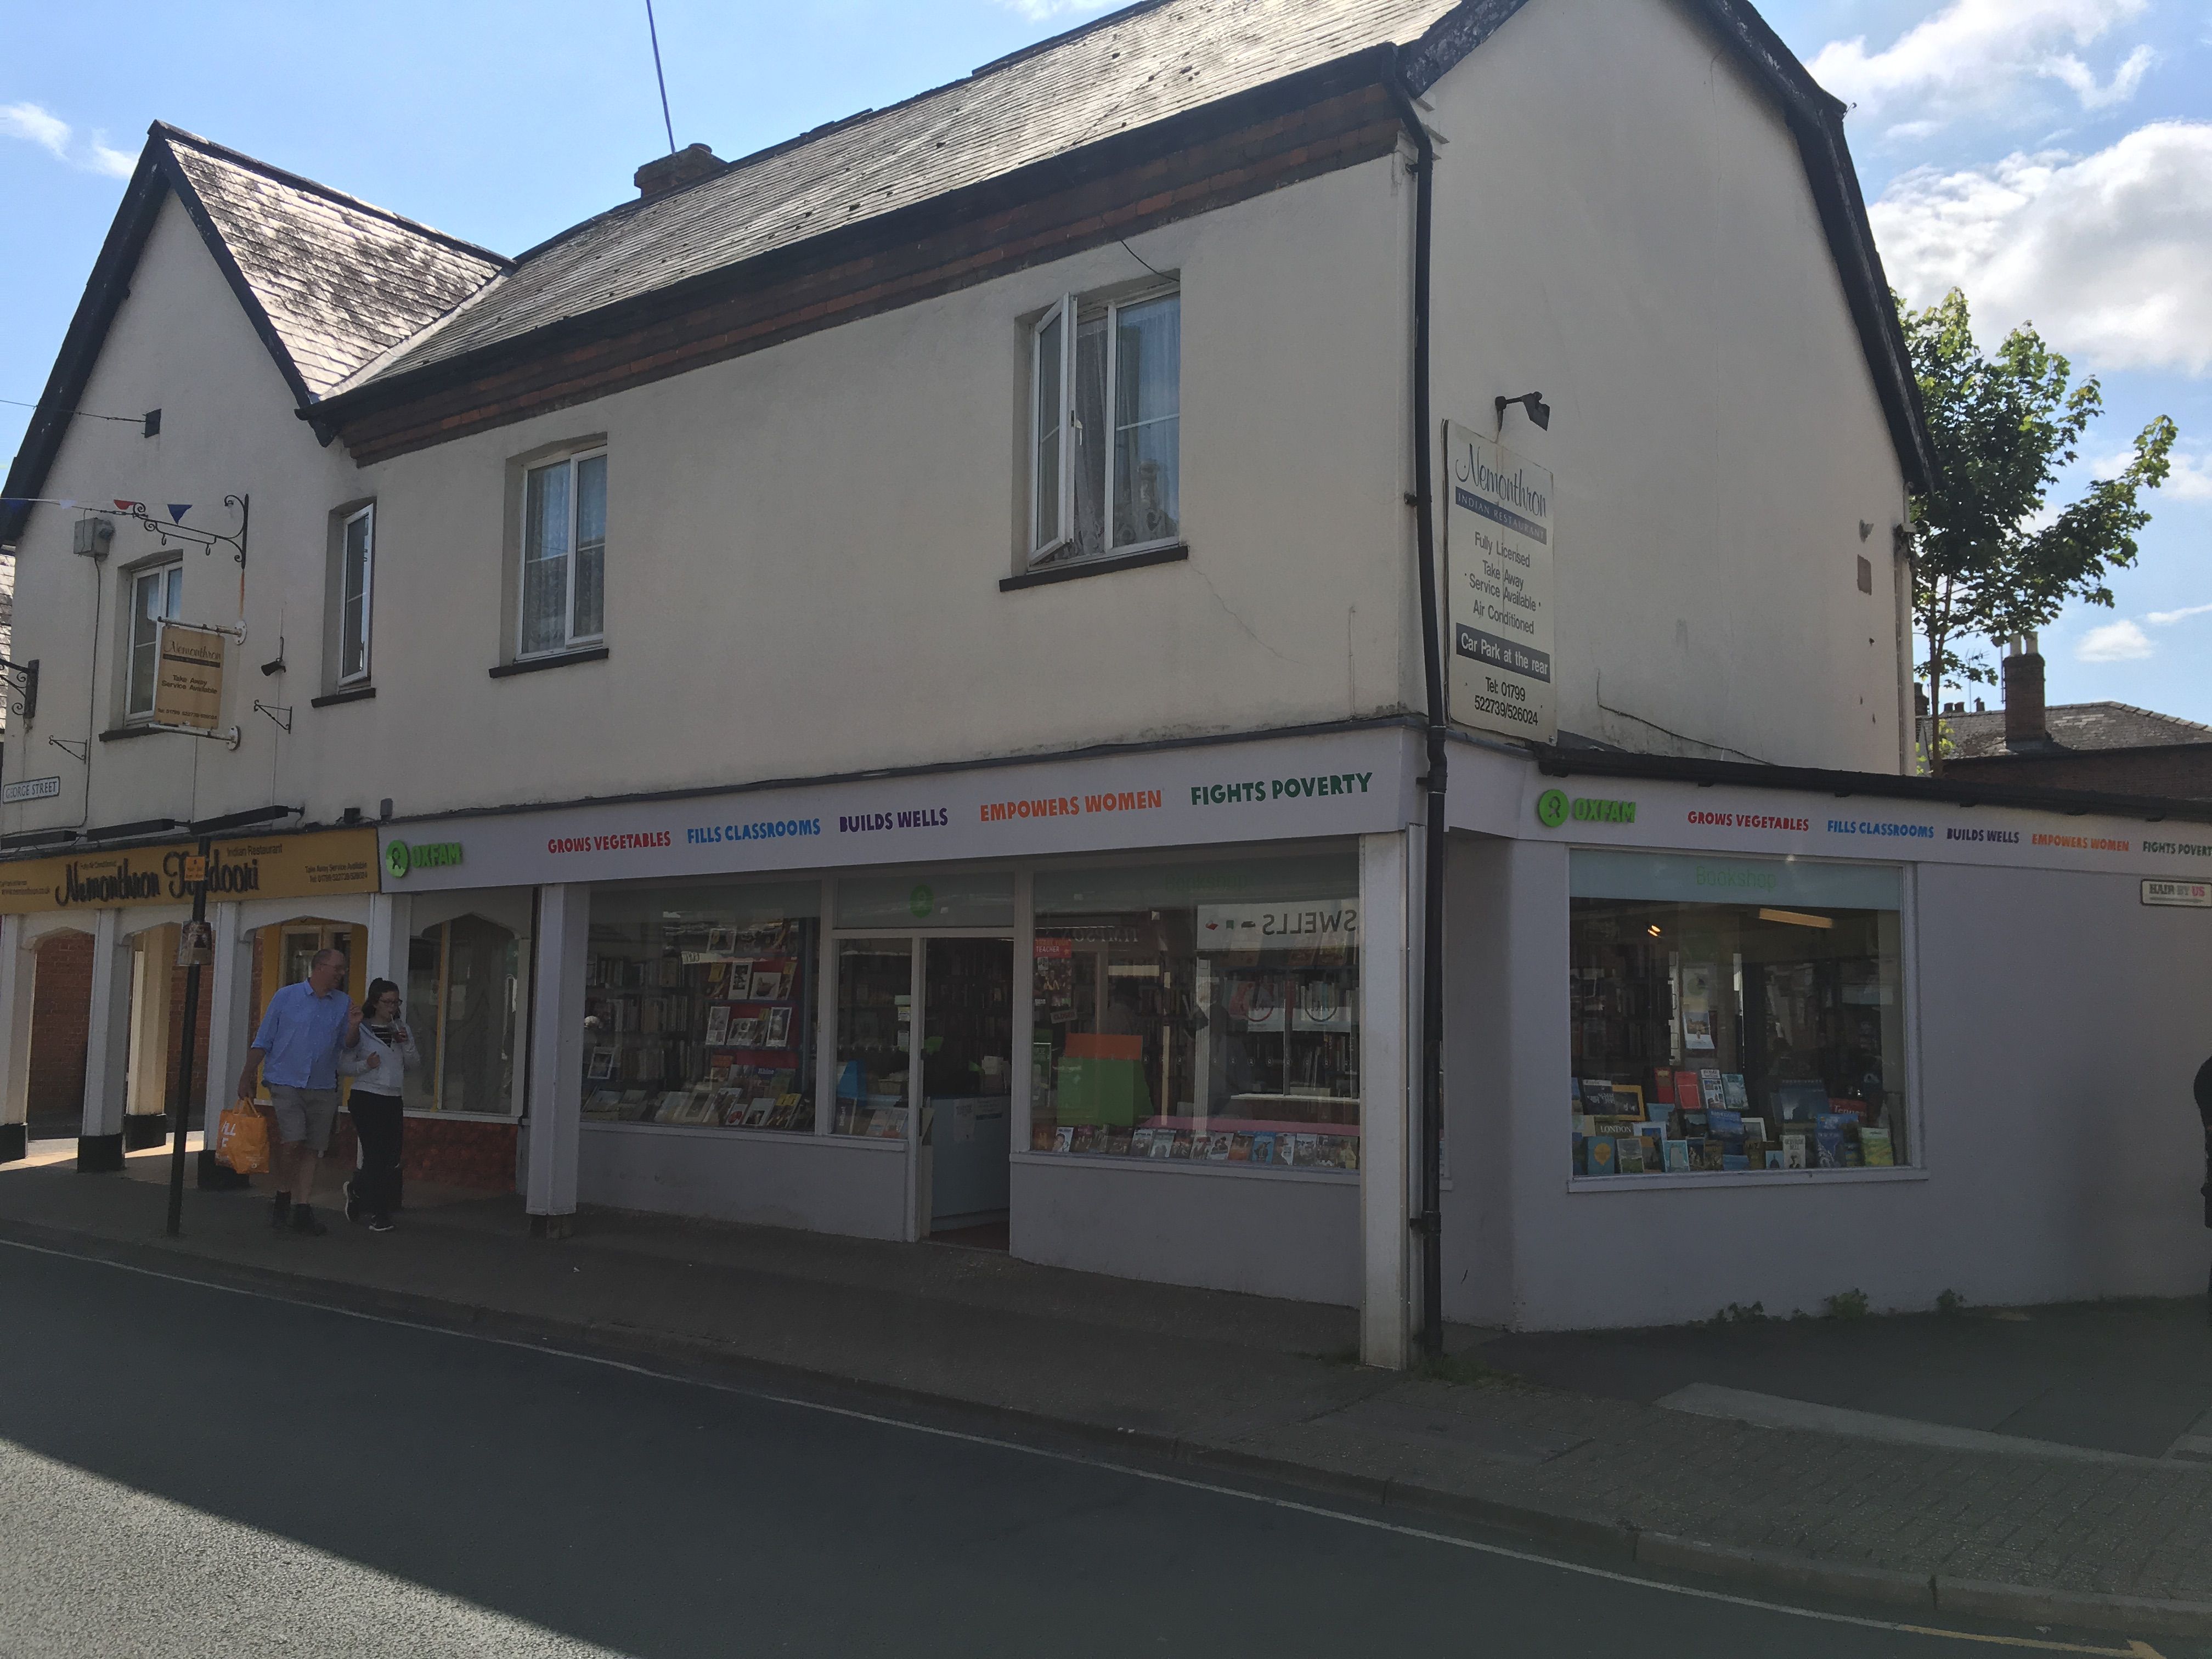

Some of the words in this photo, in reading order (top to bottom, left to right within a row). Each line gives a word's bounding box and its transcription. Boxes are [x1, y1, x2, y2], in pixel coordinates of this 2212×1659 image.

[1455, 443, 1547, 517] Nemonthron
[1458, 493, 1490, 514] INDIAN
[1494, 509, 1544, 539] RESTAURANT
[1475, 532, 1492, 555] Fully
[1497, 541, 1530, 568] Licensed
[1482, 560, 1500, 579] Take
[1504, 569, 1523, 591] Away
[1470, 573, 1500, 597] Service
[1504, 587, 1536, 612] Available
[1473, 600, 1485, 616] Air
[1488, 605, 1534, 635] Conditioned
[163, 641, 221, 660] Nemonthron
[1461, 633, 1477, 652] Car
[1481, 639, 1500, 660] Park
[1504, 648, 1512, 664] at
[1515, 651, 1528, 669] the
[1532, 659, 1548, 675] rear
[161, 680, 187, 689] Service
[189, 685, 218, 694] Available
[173, 675, 187, 683] Take
[190, 678, 208, 686] Away
[1485, 676, 1498, 694] Tel:
[1501, 682, 1525, 702] 01799
[1474, 695, 1538, 726] 522739/526024
[5, 785, 30, 799] GEORGE
[32, 781, 57, 795] STREET
[548, 837, 591, 854] GROWS
[595, 831, 671, 851] VEGETABLES
[687, 826, 721, 844] FILLS
[725, 818, 821, 841] CLASSROOMS
[839, 812, 893, 833] BUILDS
[897, 808, 949, 828] WELLS
[980, 797, 1080, 822] EMPOWERS
[1084, 789, 1162, 812] WOMEN
[1190, 781, 1266, 806] FIGHTS
[1272, 772, 1373, 799] POVERTY
[1575, 798, 1637, 823] OXFAM
[1688, 811, 1733, 827] GROWS
[1736, 814, 1809, 832] VEGETABLES
[1827, 820, 1856, 834] FILLS
[1859, 822, 1934, 838] CLASSROOMS
[1947, 827, 1984, 842] BUILDS
[1987, 830, 2019, 844] WELLS
[2032, 833, 2088, 849] EMPOWERS
[2091, 838, 2129, 852] WOMEN
[2142, 841, 2176, 854] FIGHTS
[227, 847, 246, 857] Indian
[247, 844, 283, 856] Restaurant
[411, 842, 463, 868] OXFAM
[1695, 865, 1776, 893] Bookshop
[2149, 884, 2175, 895] HAIR
[2191, 886, 2205, 897] US
